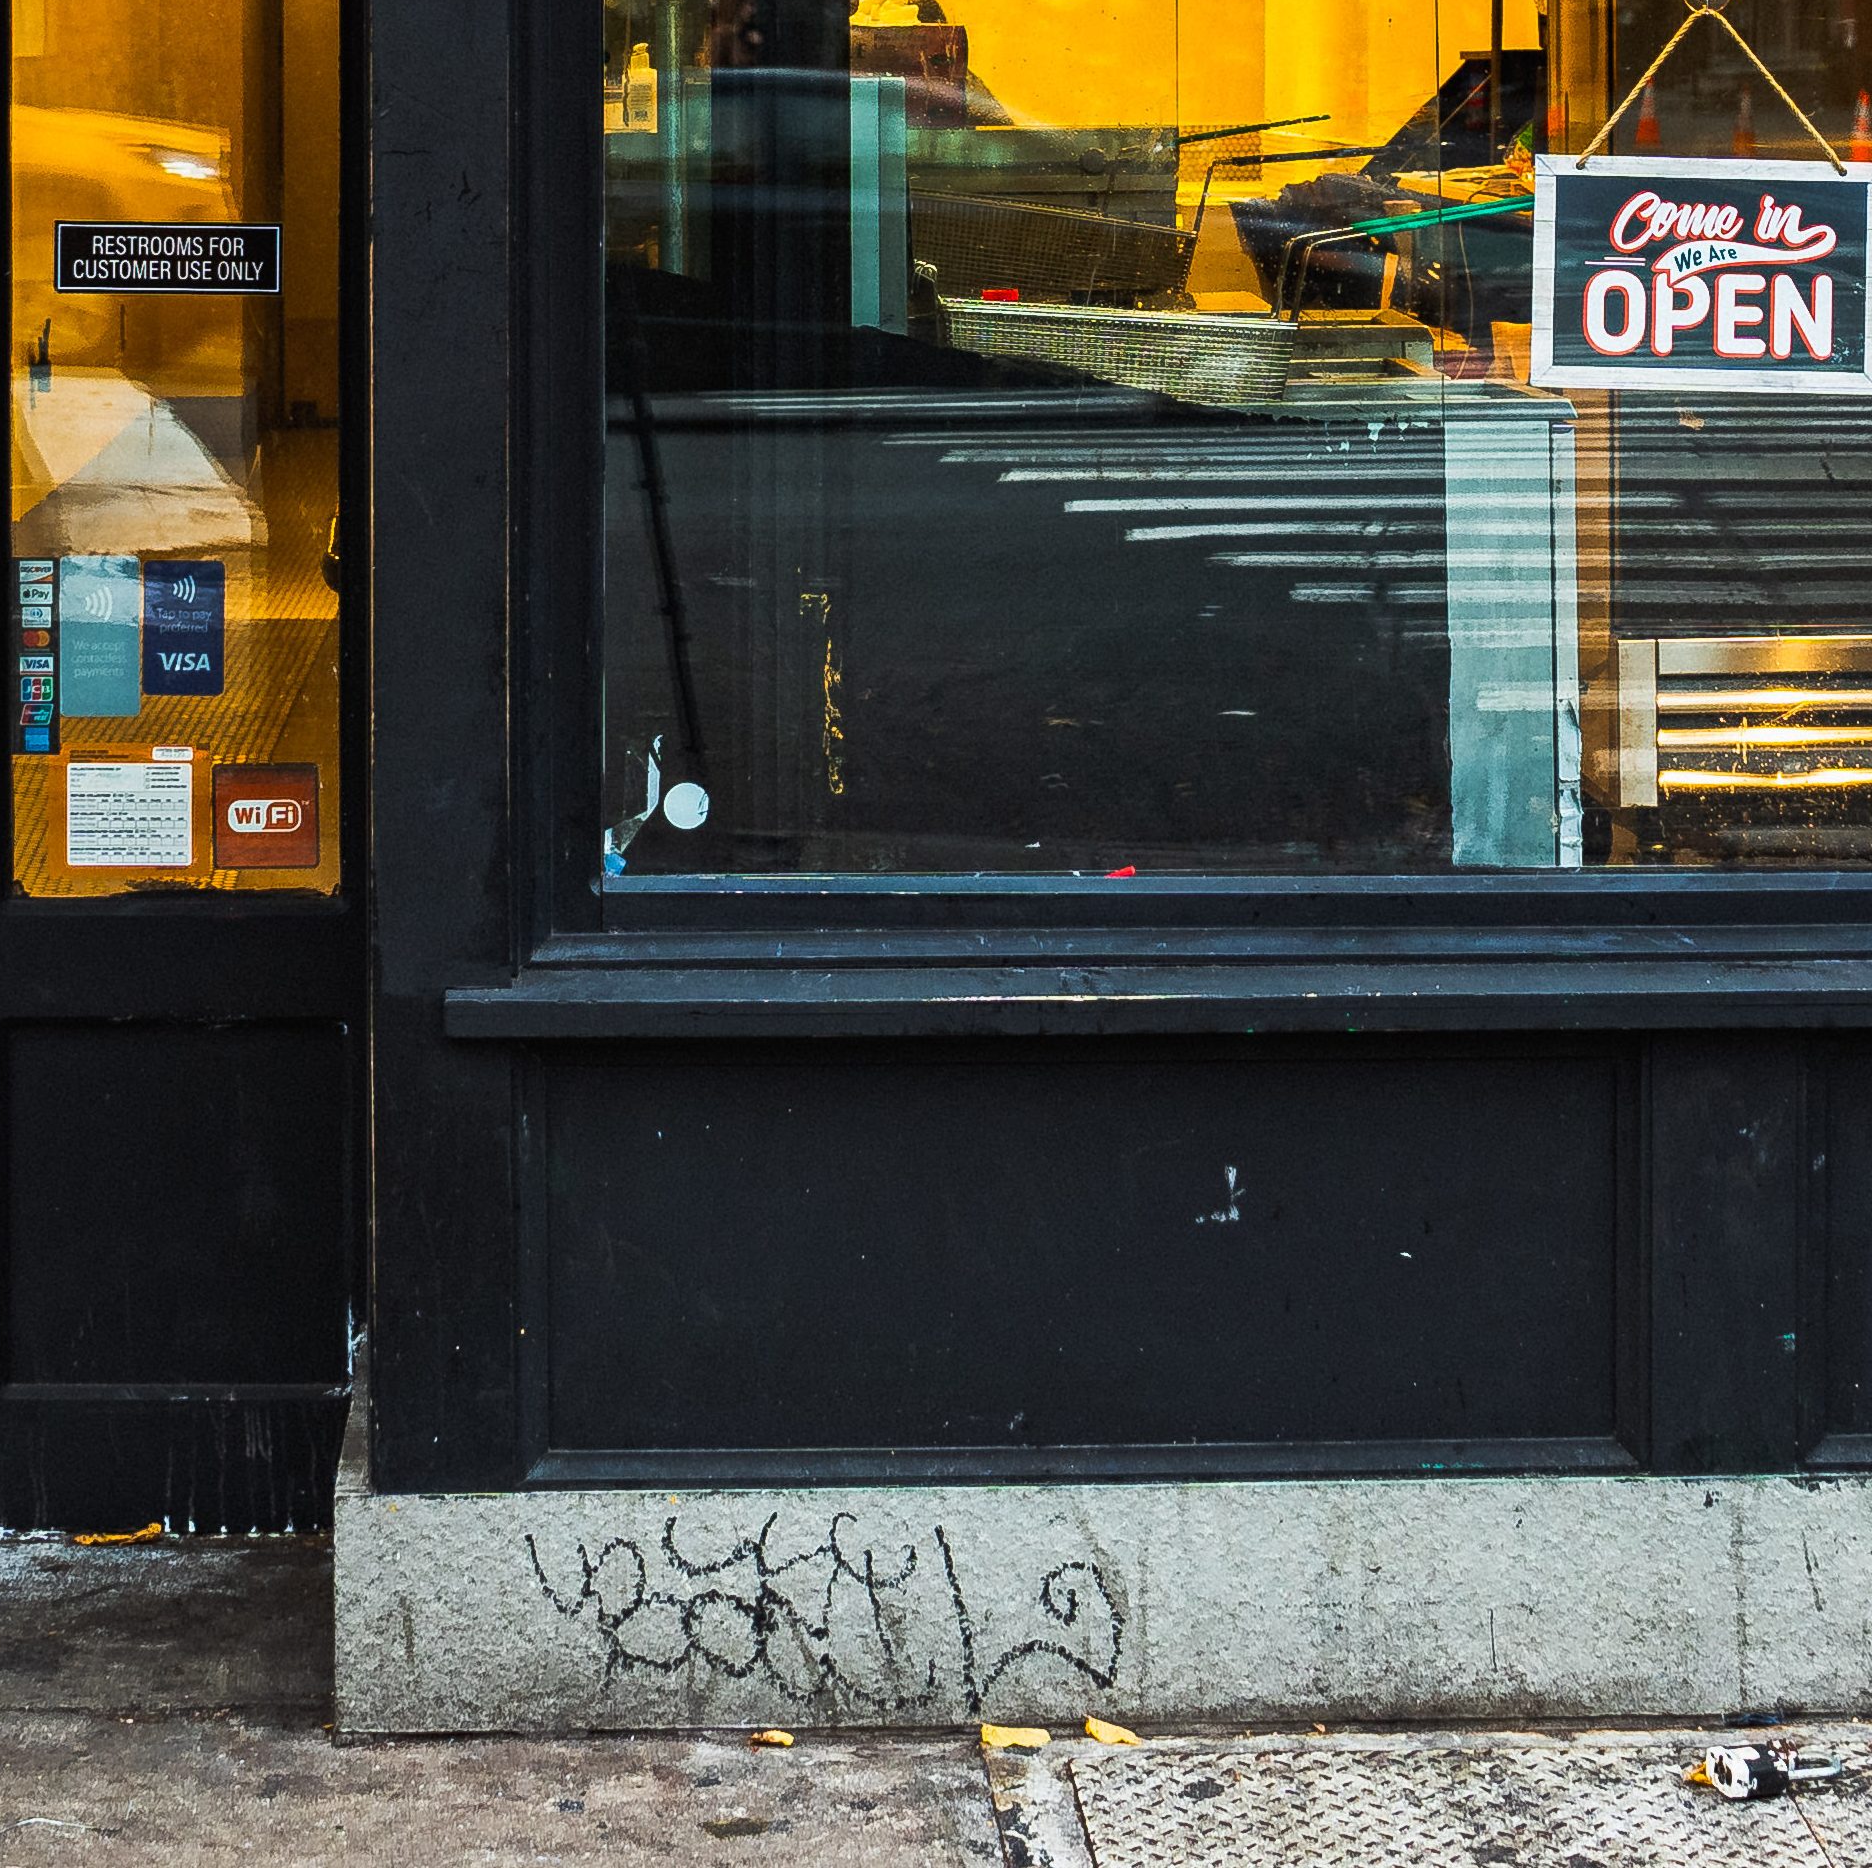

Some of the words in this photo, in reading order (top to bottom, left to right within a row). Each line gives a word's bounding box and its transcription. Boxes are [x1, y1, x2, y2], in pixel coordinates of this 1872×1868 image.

[1609, 190, 1744, 253] Come
[1754, 193, 1837, 249] in
[92, 235, 204, 256] RESTROOMS
[209, 236, 244, 257] FOR
[1674, 247, 1703, 272] We
[1709, 245, 1738, 263] Are
[73, 259, 172, 280] CUSTOMER
[177, 260, 212, 280] USE
[217, 261, 264, 281] ONLY
[1582, 268, 1834, 361] OPEN
[31, 588, 50, 600] Pay
[156, 607, 174, 621] Tap
[178, 609, 190, 619] to
[192, 609, 213, 622] pay
[160, 623, 208, 635] preferred
[72, 641, 86, 650] We
[87, 641, 126, 652] accept
[24, 658, 50, 669] VISA
[71, 653, 127, 664] contactless
[157, 652, 211, 671] VISA
[74, 665, 124, 678] payments
